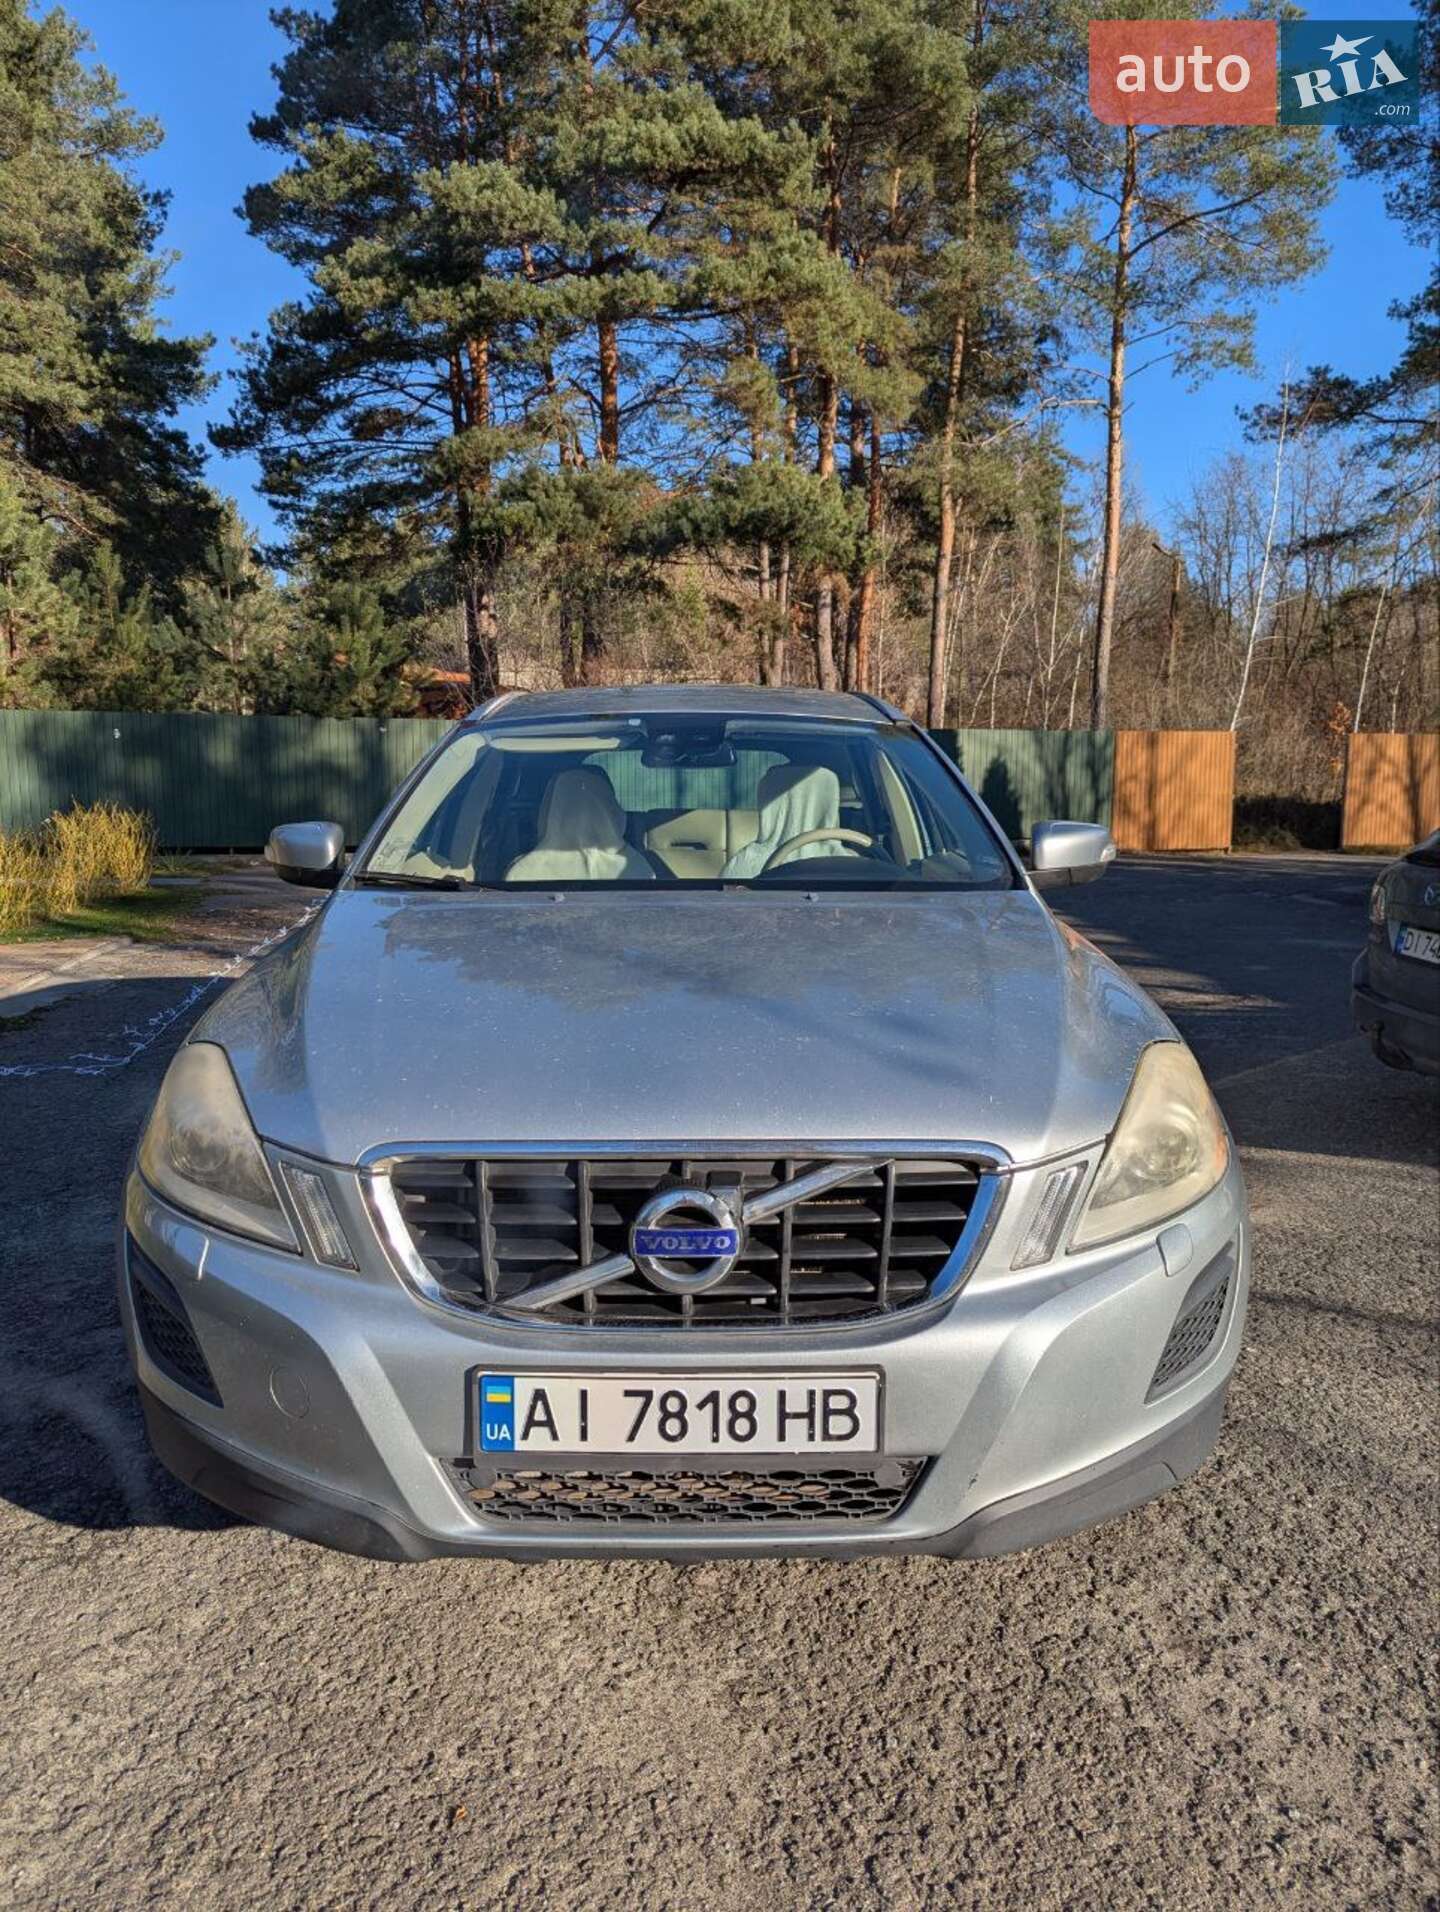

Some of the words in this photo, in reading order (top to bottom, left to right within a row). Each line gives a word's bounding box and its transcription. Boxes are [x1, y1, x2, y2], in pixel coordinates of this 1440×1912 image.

[640, 1235, 731, 1250] VOLVO
[623, 1389, 758, 1443] 7818
[777, 1389, 861, 1442] HB
[486, 1423, 512, 1440] UA
